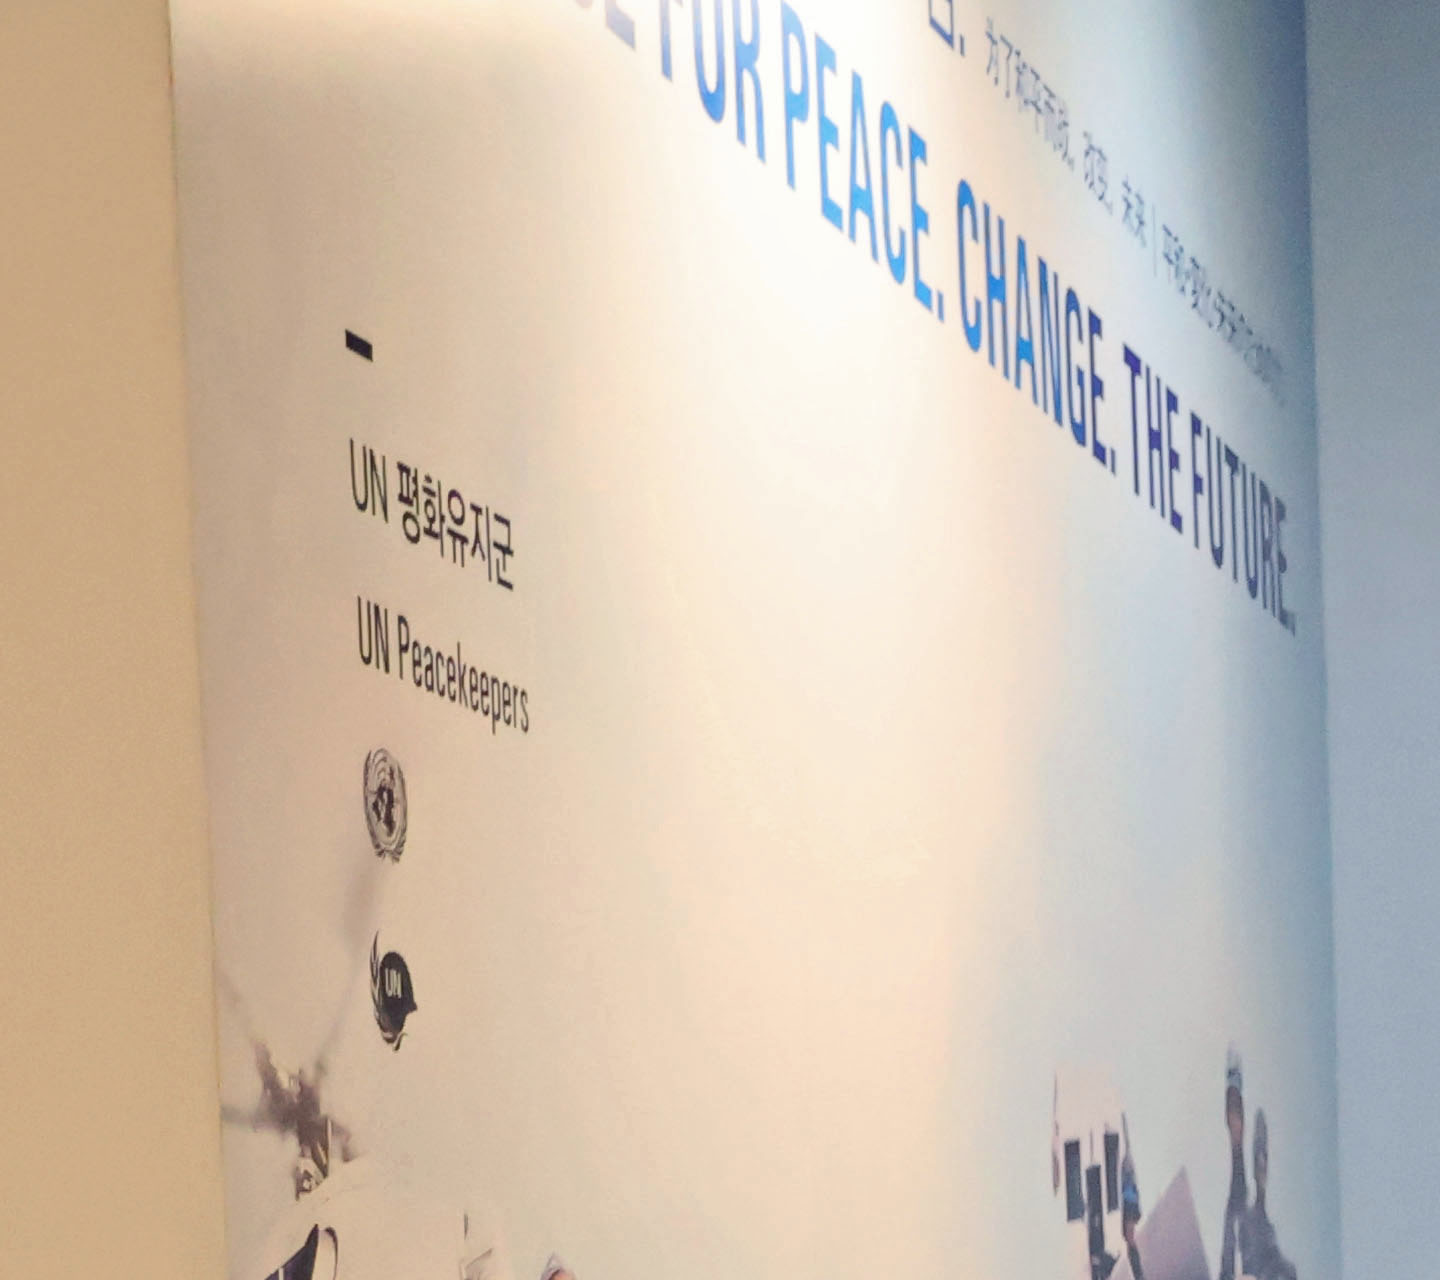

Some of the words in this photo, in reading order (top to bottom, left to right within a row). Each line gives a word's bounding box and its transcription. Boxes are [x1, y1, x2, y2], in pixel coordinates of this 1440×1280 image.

[781, 0, 945, 324] PEACE.
[957, 178, 1117, 477] CHANGE.
[1123, 341, 1184, 535] THE
[1190, 410, 1297, 637] FUTURE.
[349, 437, 389, 525] UN
[396, 460, 515, 591] 평화유지군
[356, 595, 390, 675] UN
[397, 614, 530, 736] Peacekeepers
[385, 967, 402, 999] UN
